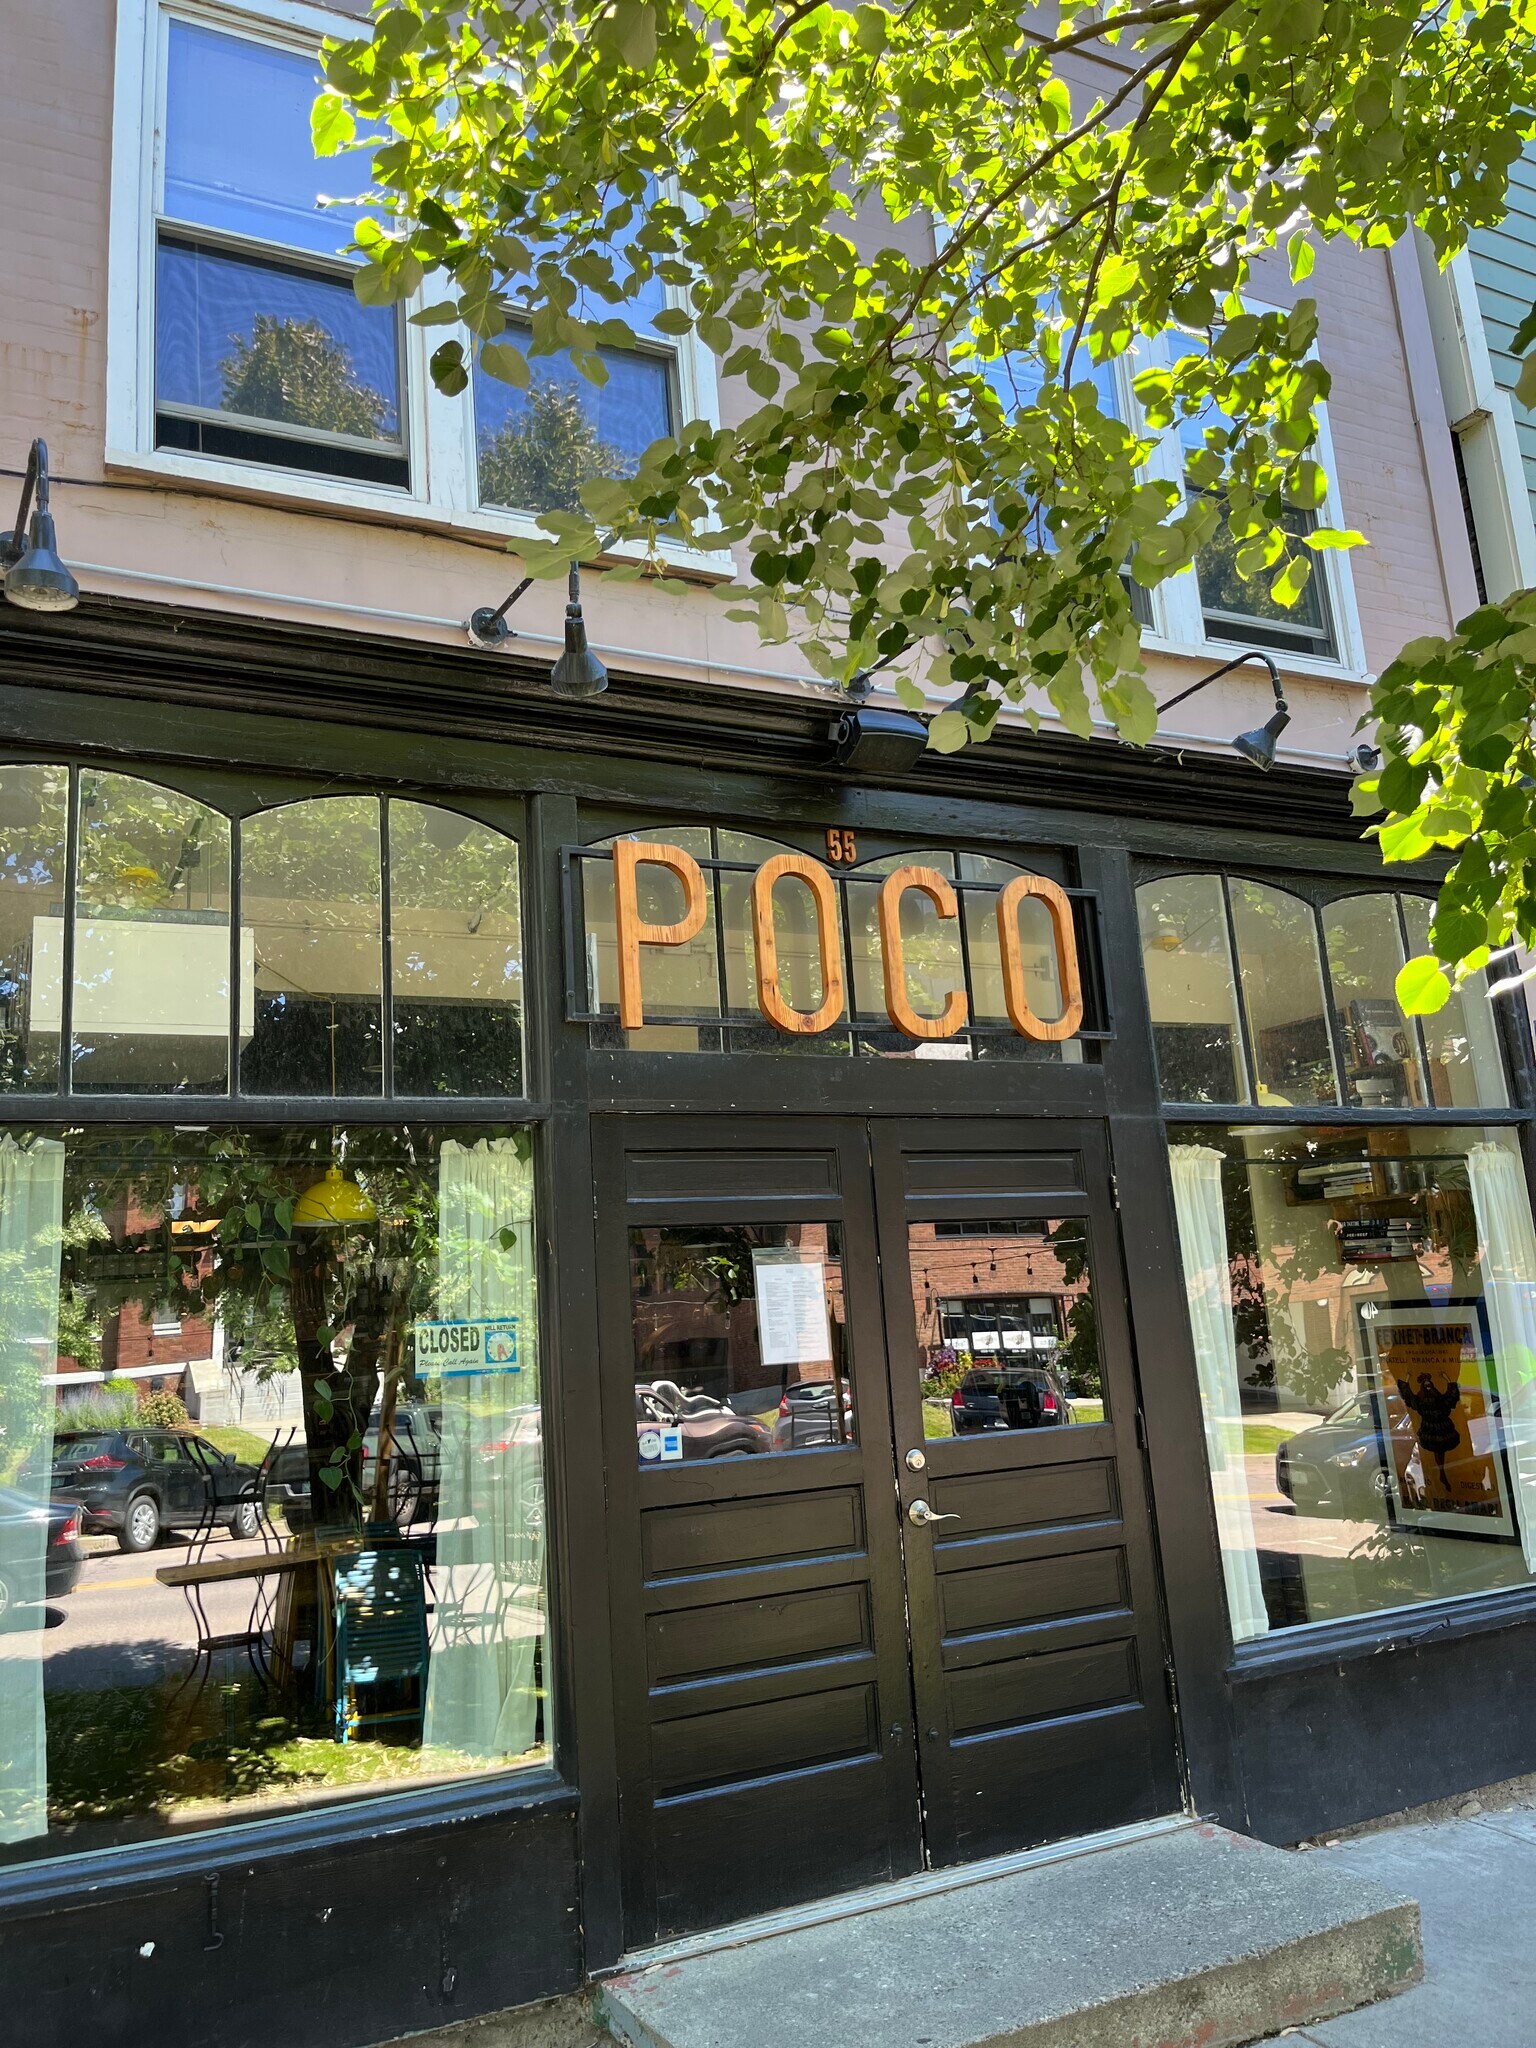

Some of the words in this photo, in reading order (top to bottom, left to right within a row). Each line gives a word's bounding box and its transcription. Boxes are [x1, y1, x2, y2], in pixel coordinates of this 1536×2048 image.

[826, 829, 857, 864] 55
[612, 839, 1083, 1042] POCO
[419, 1326, 480, 1355] CLOSED
[1376, 1326, 1472, 1346] FERNET-BRANCA
[442, 1358, 457, 1367] Call
[459, 1357, 479, 1366] Again
